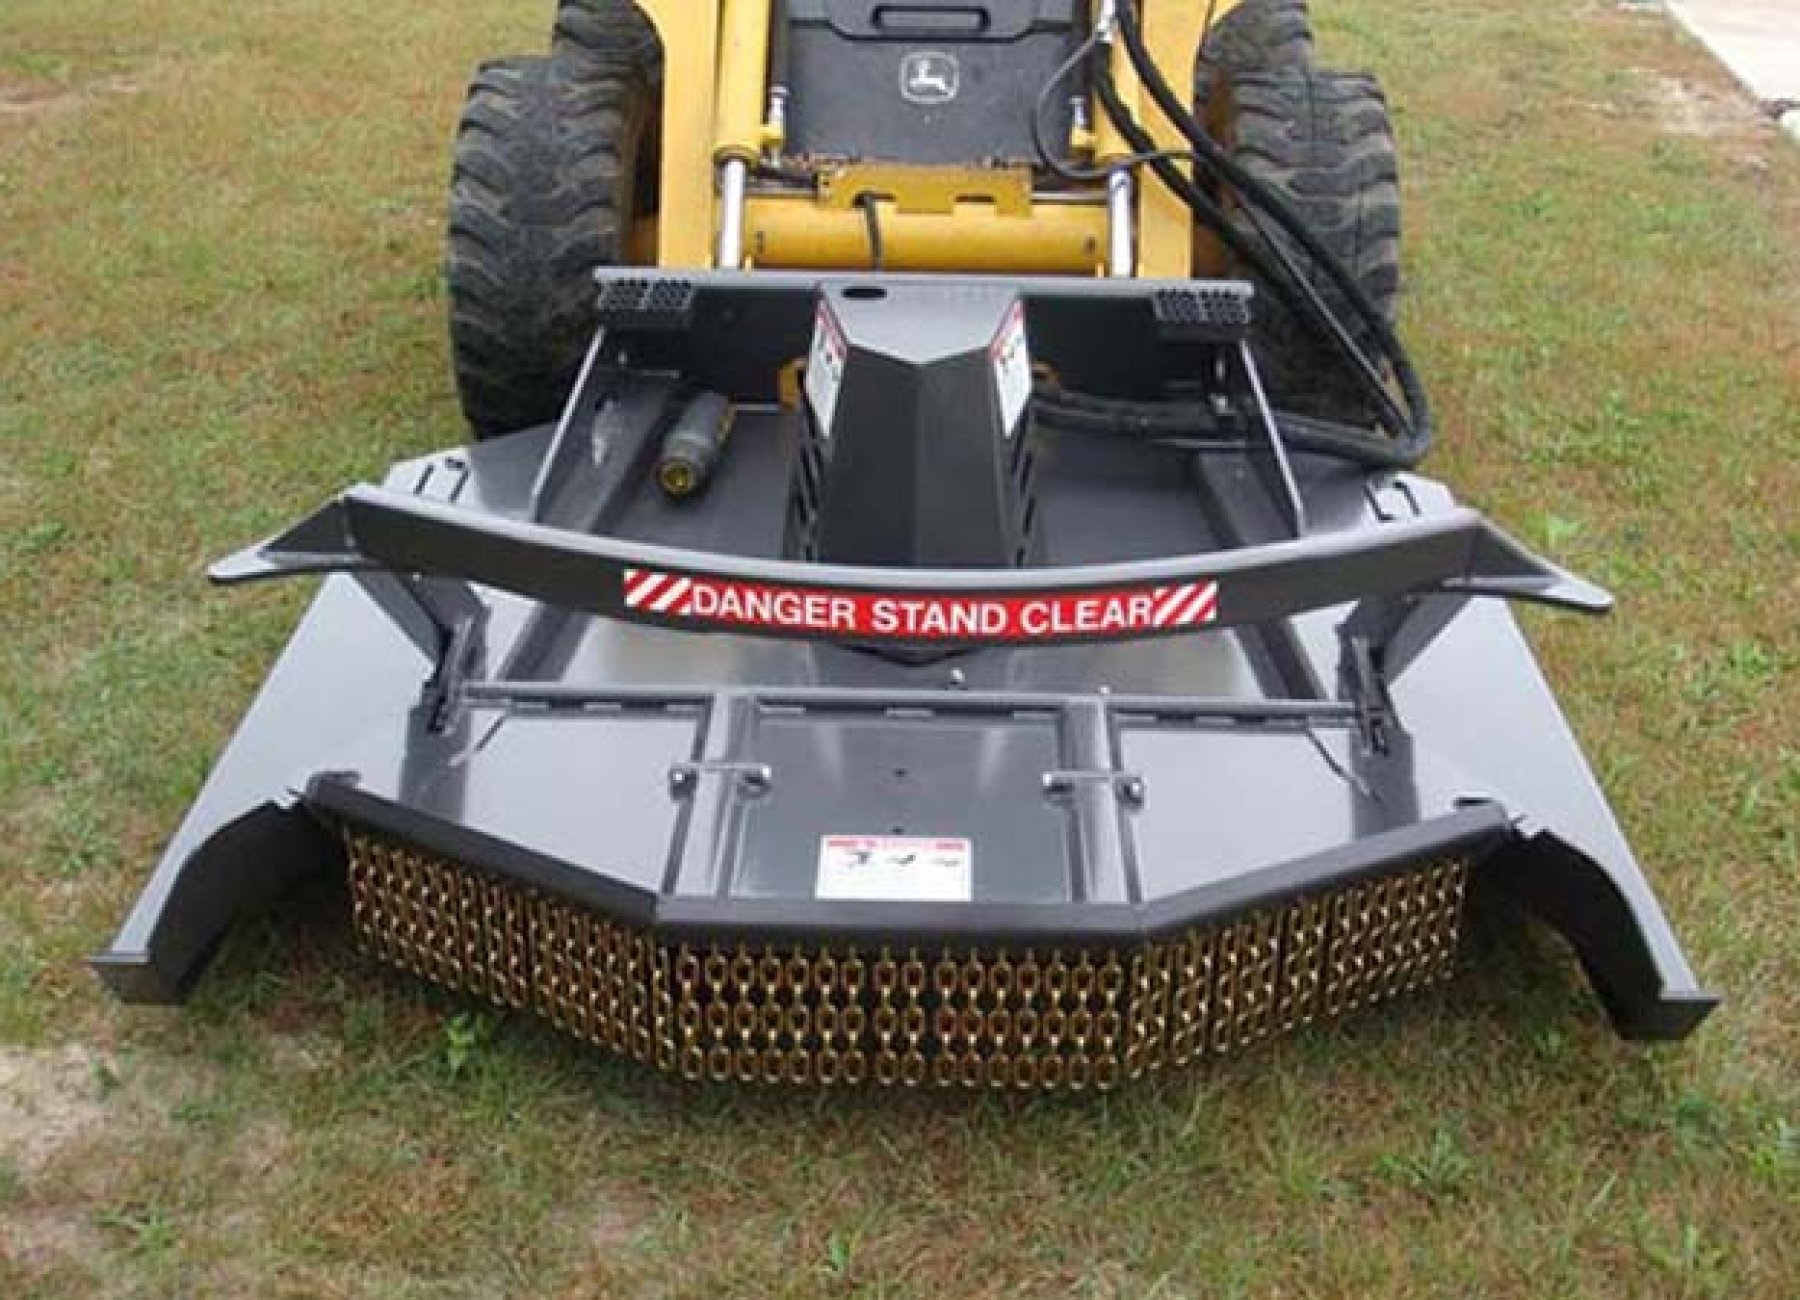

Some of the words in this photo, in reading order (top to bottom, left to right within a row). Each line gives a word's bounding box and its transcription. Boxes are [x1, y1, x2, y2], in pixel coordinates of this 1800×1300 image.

[692, 584, 856, 627] DANGER
[871, 600, 1006, 634] STAND
[1021, 594, 1153, 634] CLEAR
